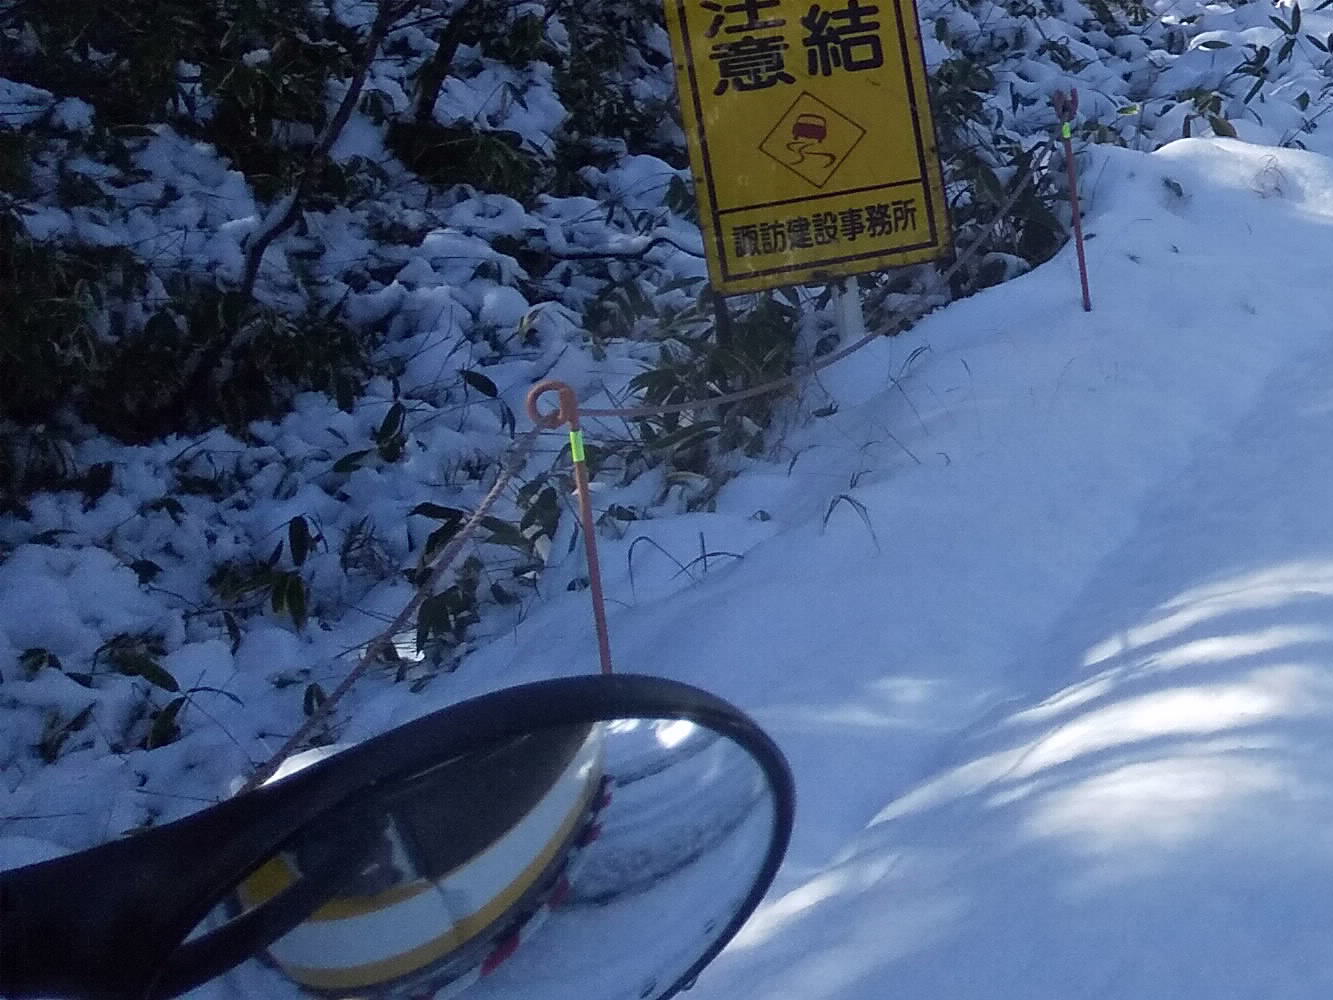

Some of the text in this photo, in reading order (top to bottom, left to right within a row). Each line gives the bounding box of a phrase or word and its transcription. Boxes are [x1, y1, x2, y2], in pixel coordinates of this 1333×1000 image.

[732, 199, 917, 258] 諏訪建設事務所
